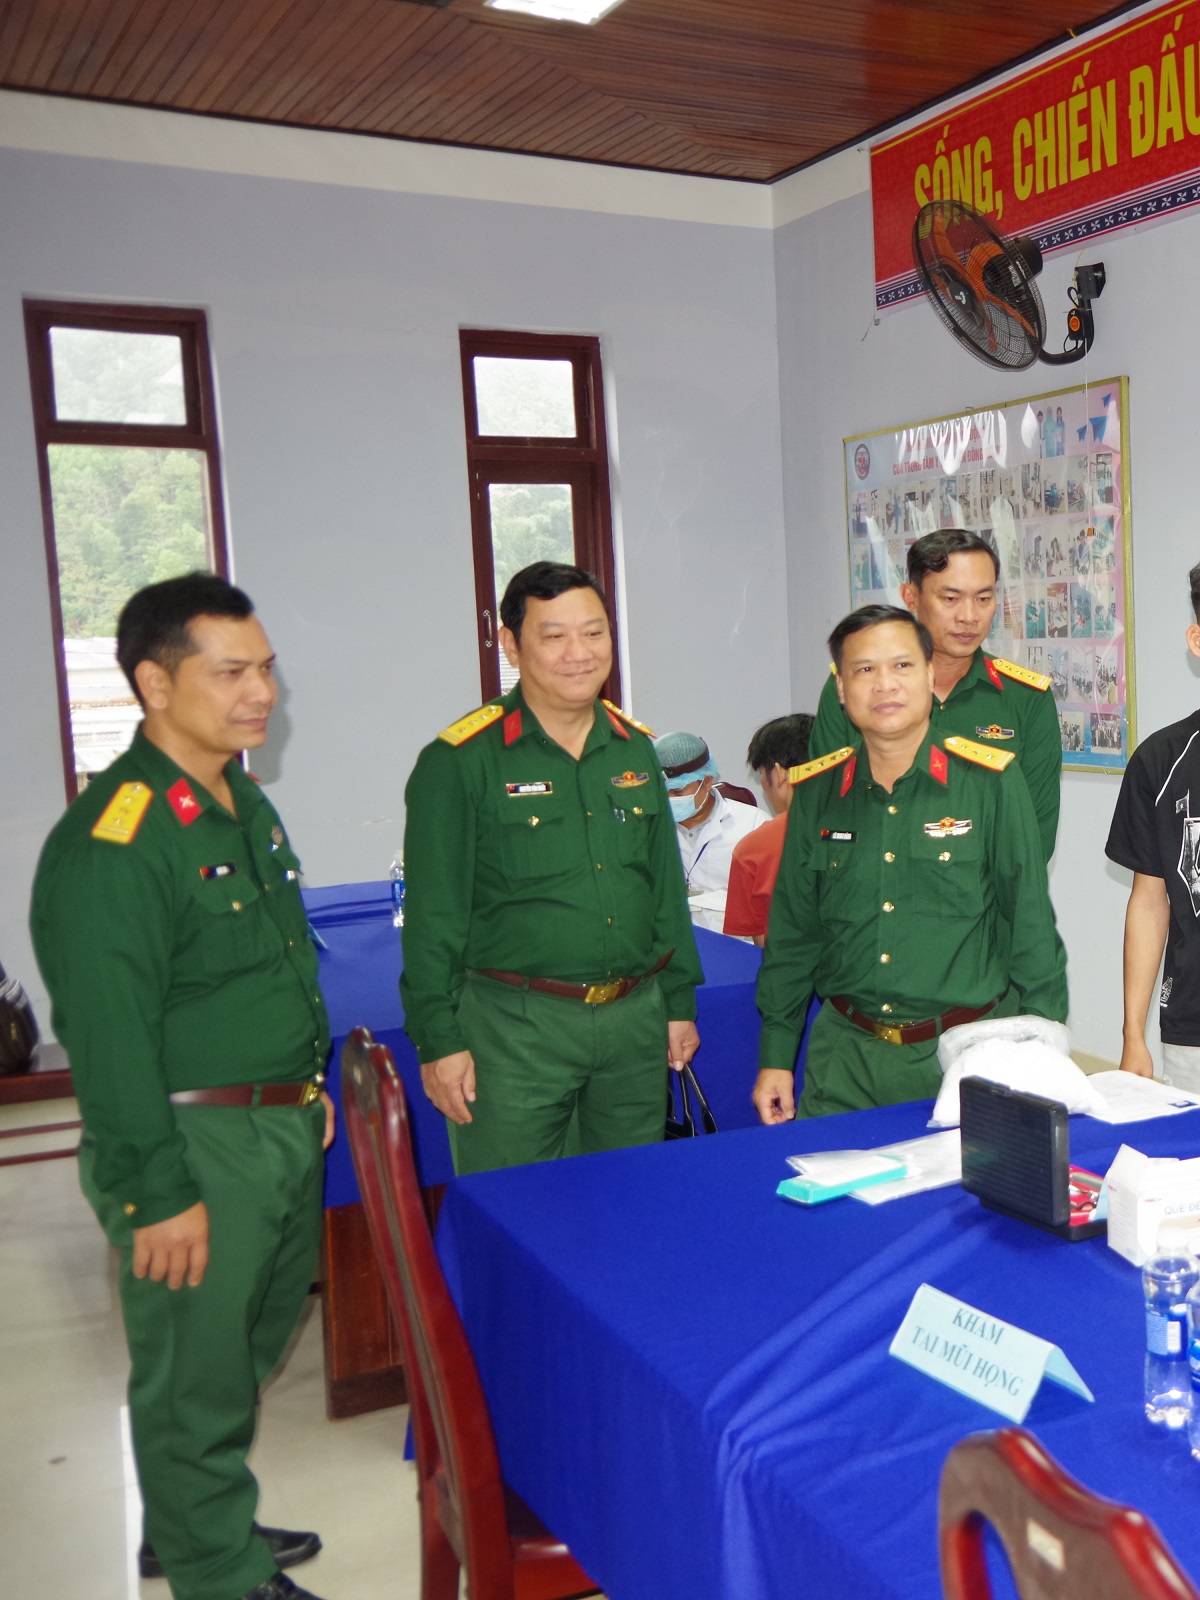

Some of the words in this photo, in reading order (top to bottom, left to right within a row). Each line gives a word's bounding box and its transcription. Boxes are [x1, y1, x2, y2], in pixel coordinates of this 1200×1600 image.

[914, 125, 1003, 240] SỐNG,
[1013, 60, 1118, 201] CHIẾN
[911, 1325, 939, 1353] TAI
[939, 1343, 973, 1371] MŨI
[972, 1356, 1024, 1397] HỌNG
